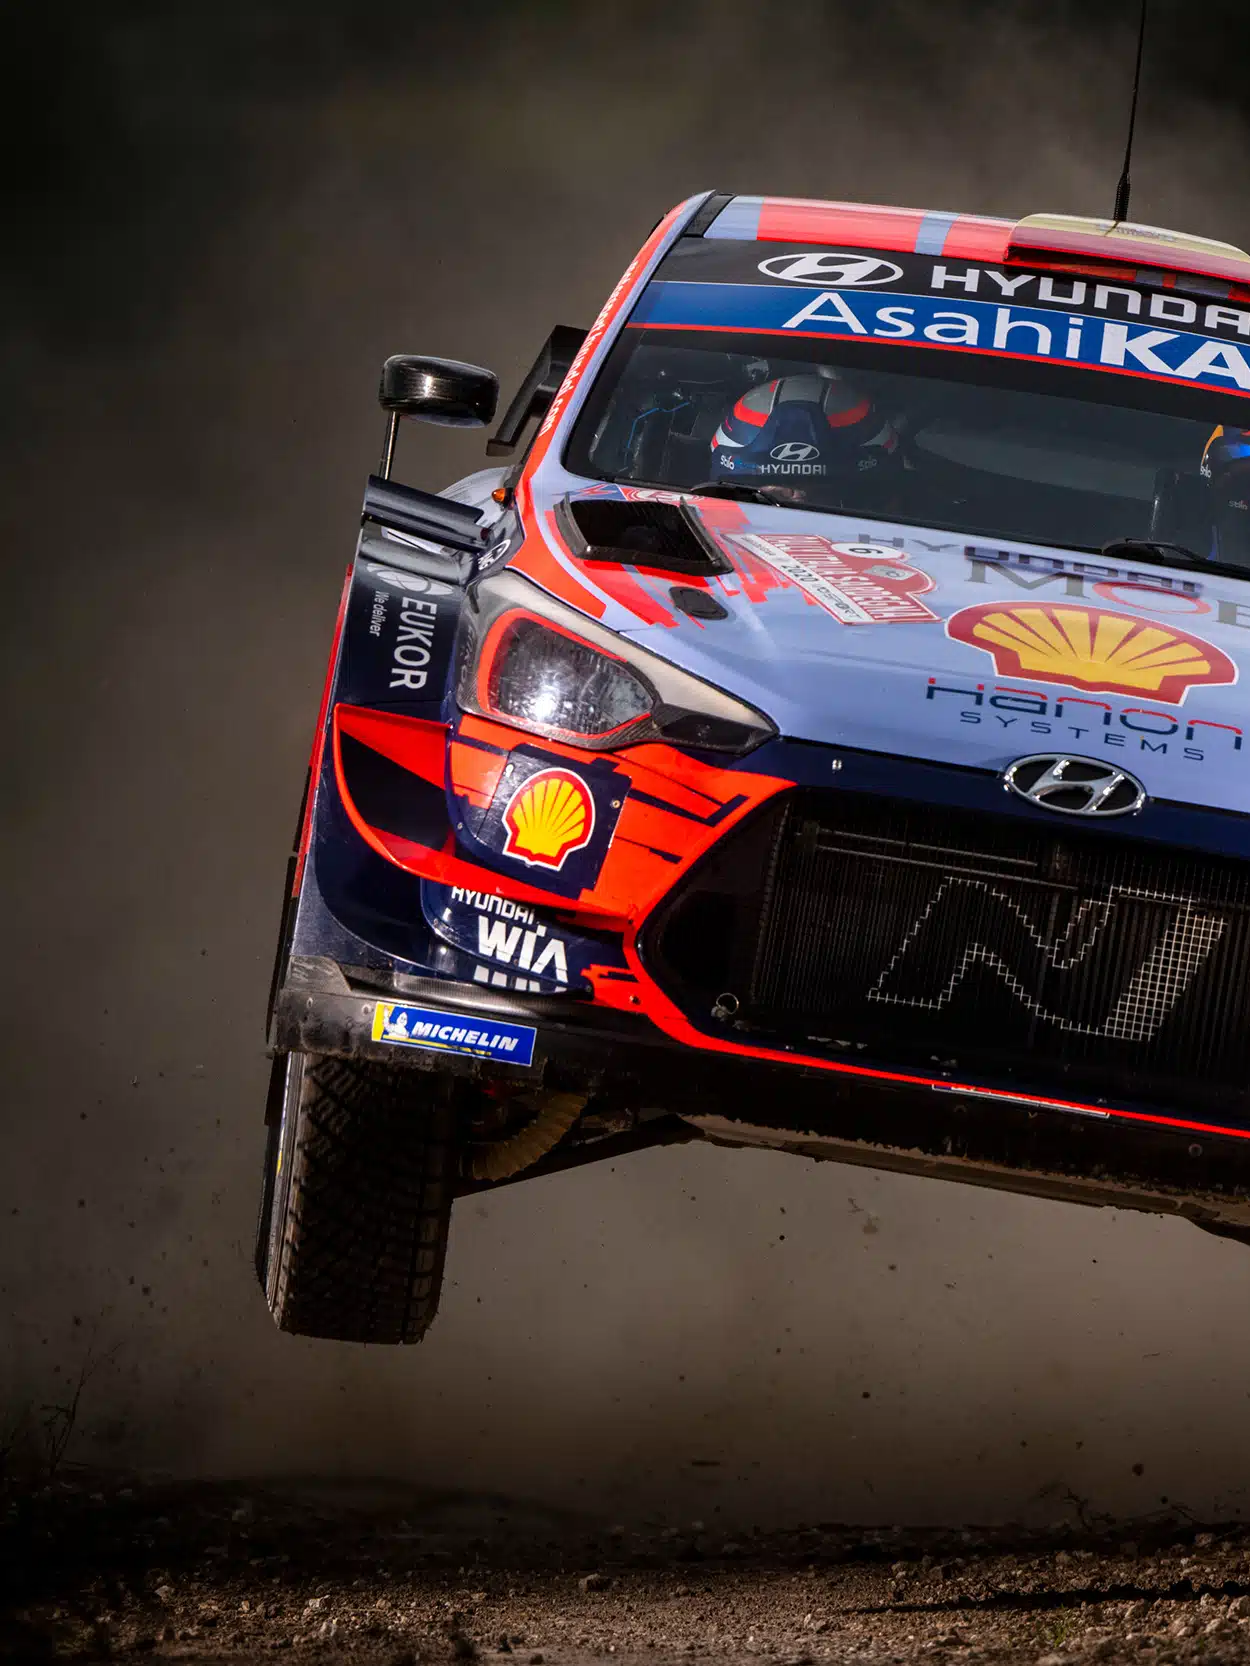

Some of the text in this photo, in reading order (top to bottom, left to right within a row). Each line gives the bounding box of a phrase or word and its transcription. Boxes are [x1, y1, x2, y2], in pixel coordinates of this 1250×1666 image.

[761, 463, 827, 475] HYUNDAI
[760, 535, 834, 554] RALLY
[789, 553, 859, 575] ITALIA
[857, 533, 1201, 592] HYUNDAI
[780, 564, 820, 582] 2020
[369, 590, 390, 637] We deliver
[817, 575, 931, 618] SARDEGNA
[389, 596, 438, 690] EUKOR
[960, 711, 1204, 761] SYSTEMS
[452, 886, 535, 925] HYUNDAI
[477, 915, 569, 983] WIA
[411, 1021, 519, 1051] MICHELIN
